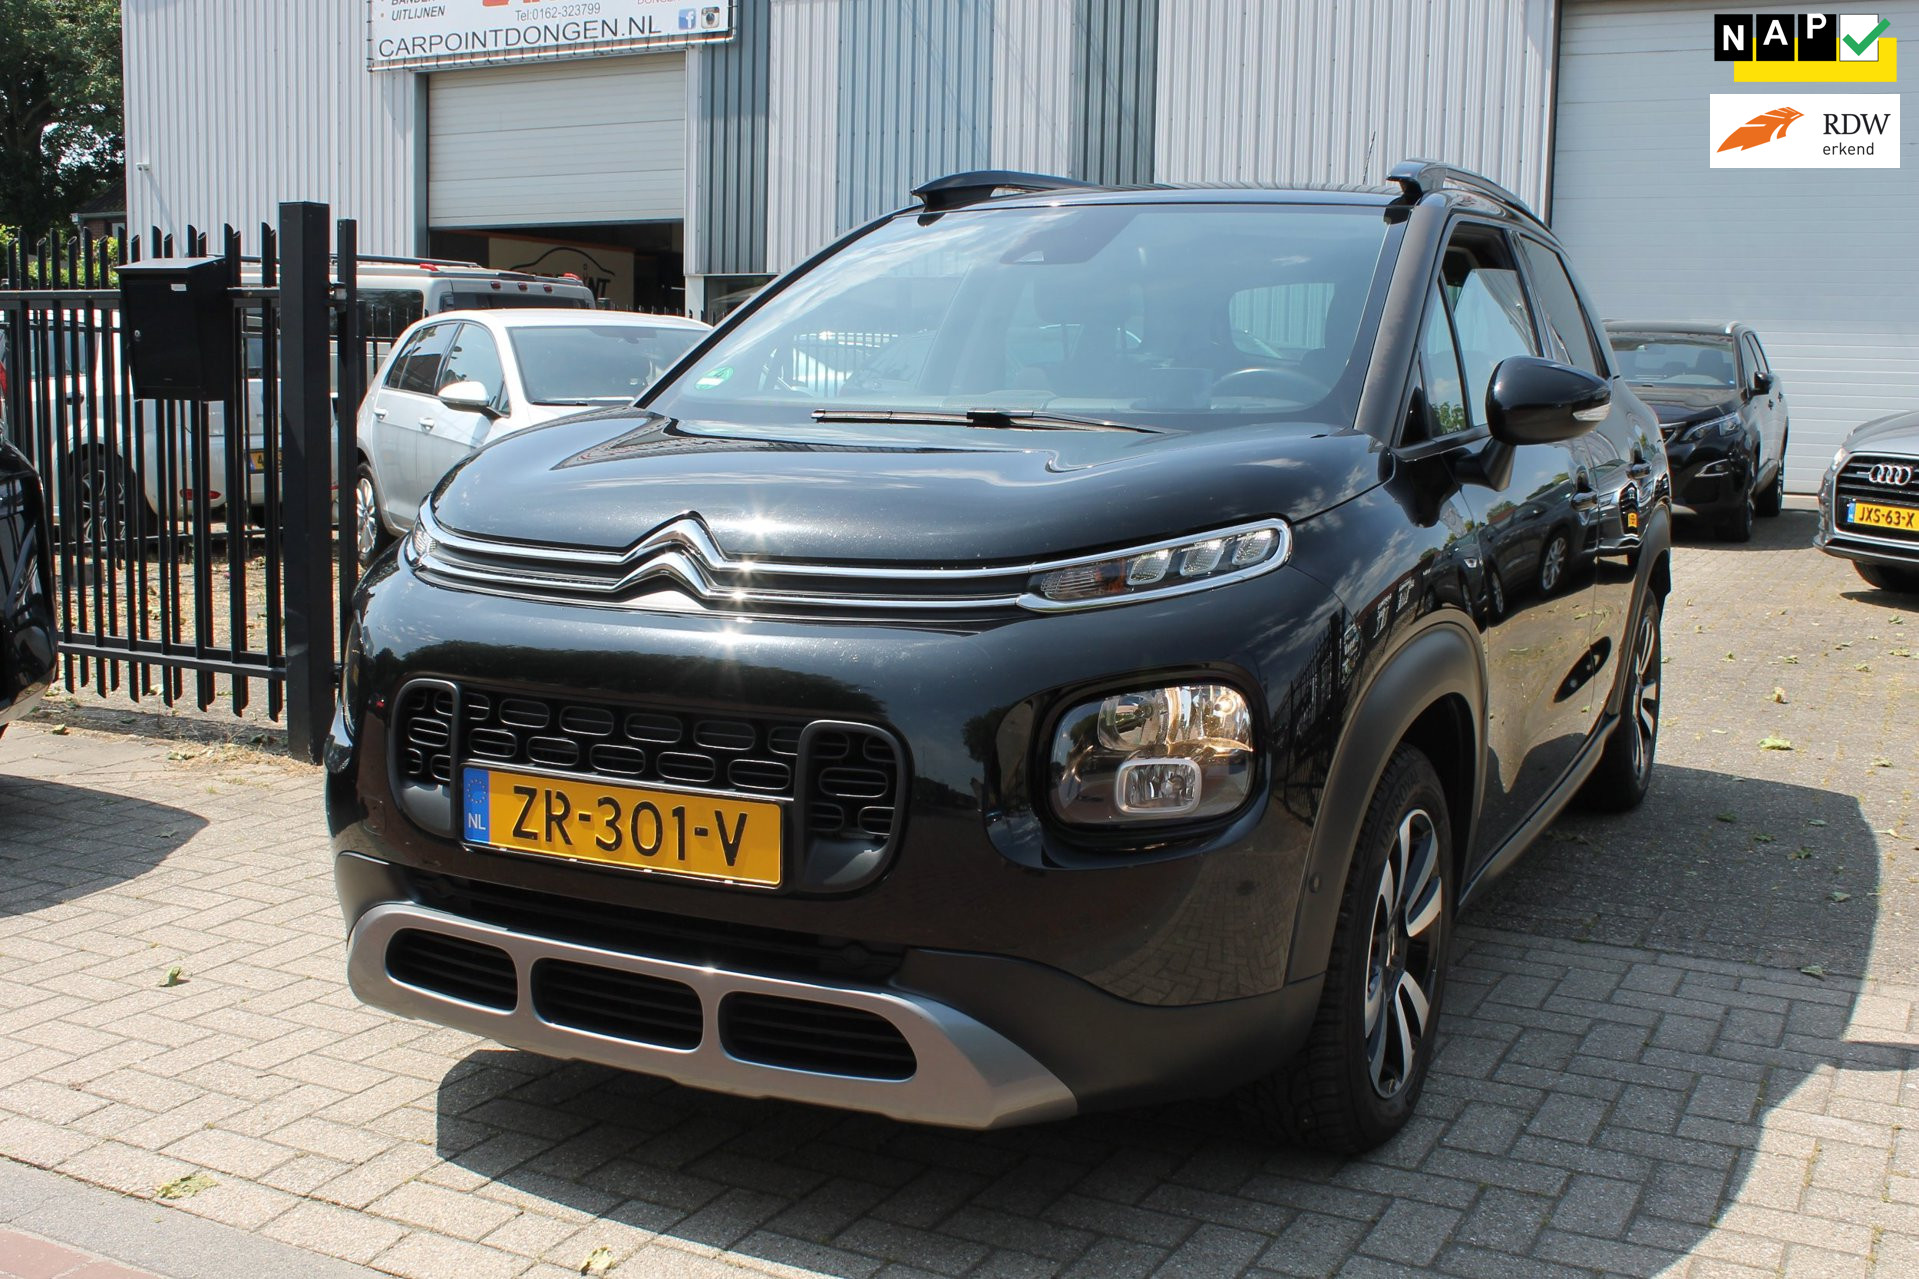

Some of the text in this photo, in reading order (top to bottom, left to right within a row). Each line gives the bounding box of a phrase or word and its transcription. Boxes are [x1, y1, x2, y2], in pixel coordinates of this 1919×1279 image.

[391, 5, 446, 21] UITLIJNEN
[514, 2, 601, 21] Tel:0162-323799
[379, 15, 662, 57] CARPOINTDONGEN.NL
[1859, 507, 1915, 528] JXS-63-X
[468, 812, 486, 830] NL
[512, 785, 747, 867] ZR-301-V
